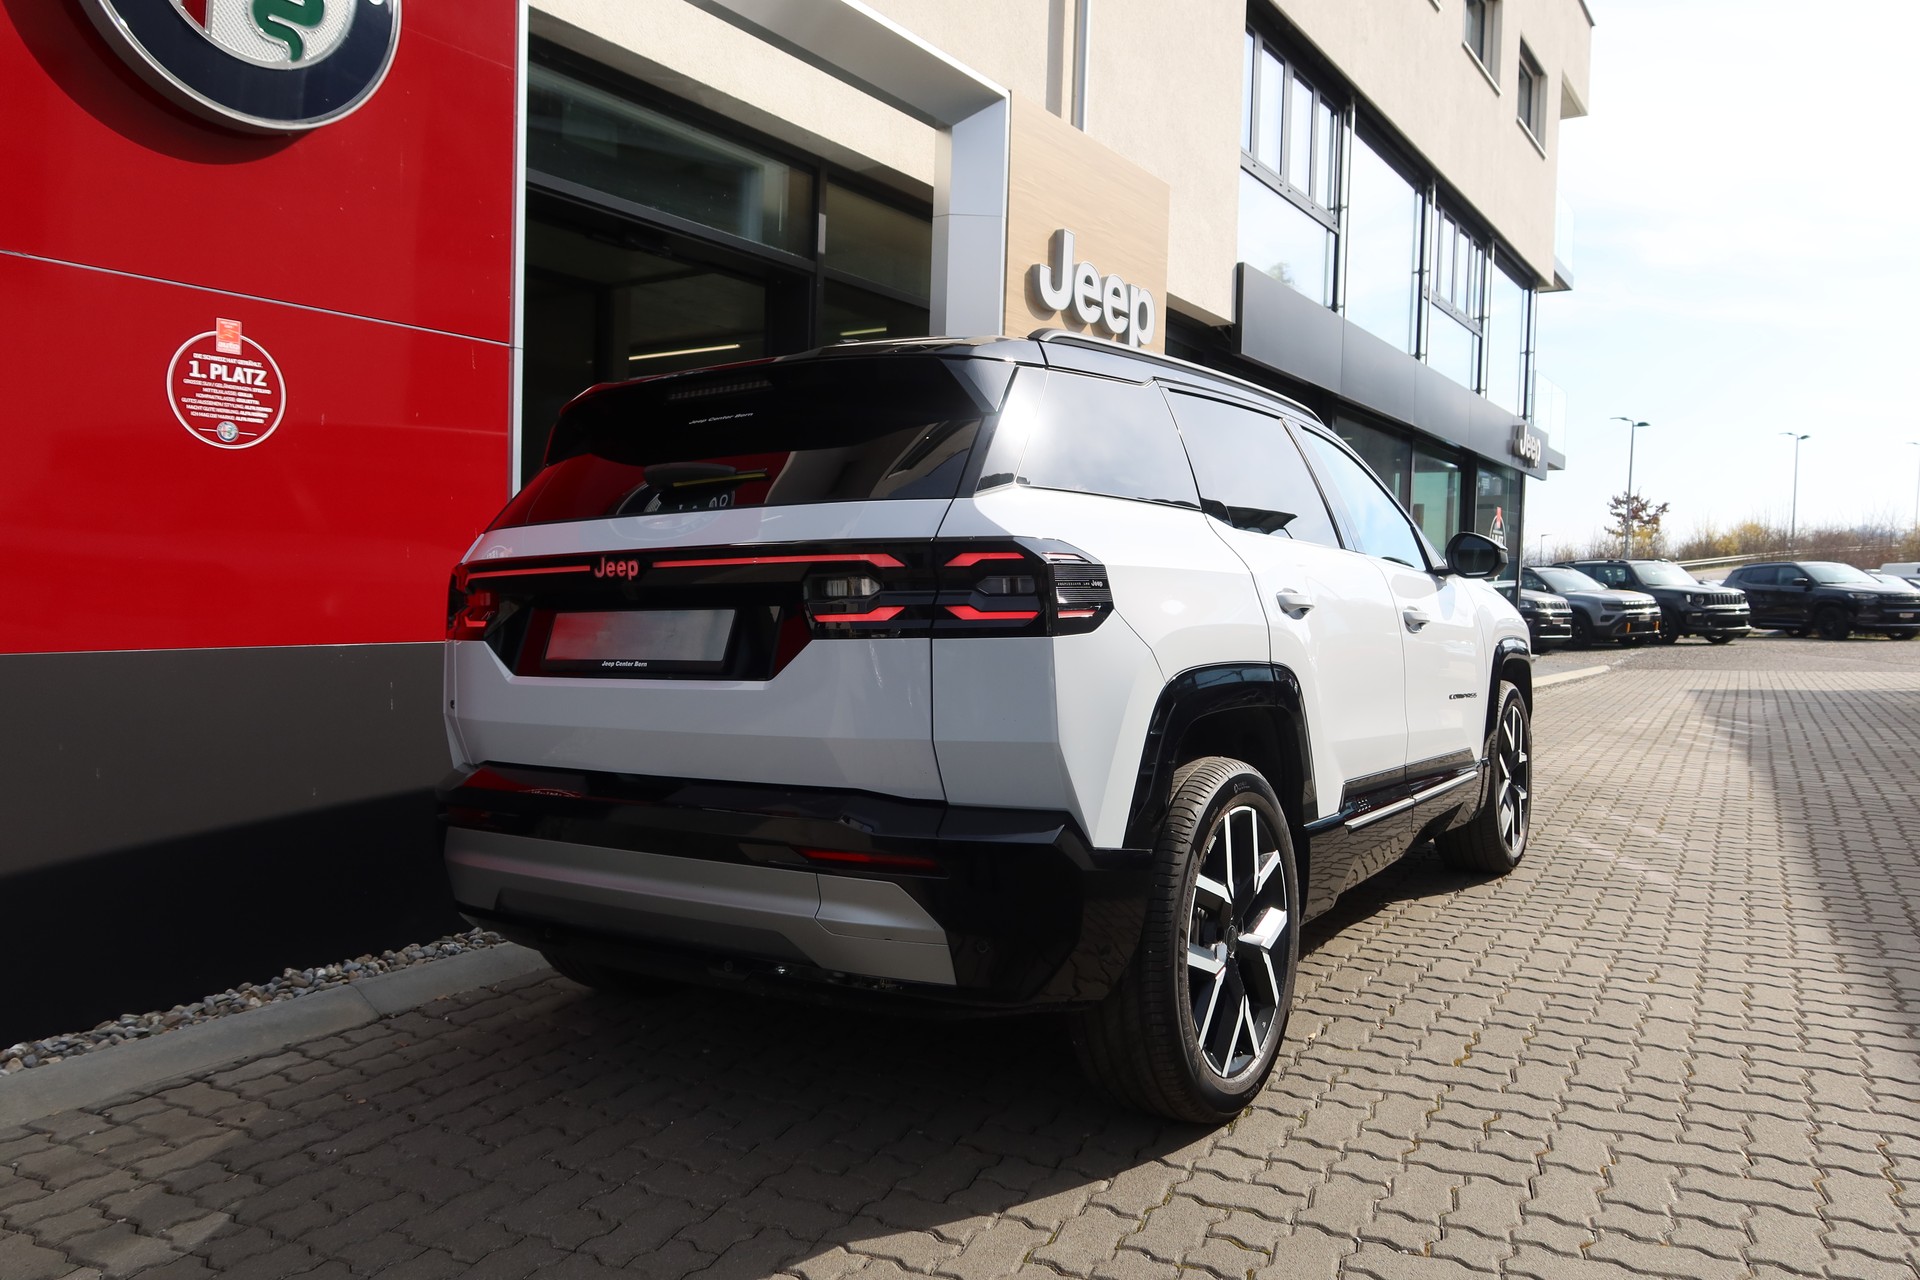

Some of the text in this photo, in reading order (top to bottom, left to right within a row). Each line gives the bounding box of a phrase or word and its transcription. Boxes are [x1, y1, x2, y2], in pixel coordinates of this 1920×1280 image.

[1036, 228, 1155, 347] Jeep
[188, 360, 267, 387] 1. PLATZ
[1517, 424, 1541, 467] Jeep
[594, 557, 639, 580] Jeep
[601, 660, 615, 668] Jeep
